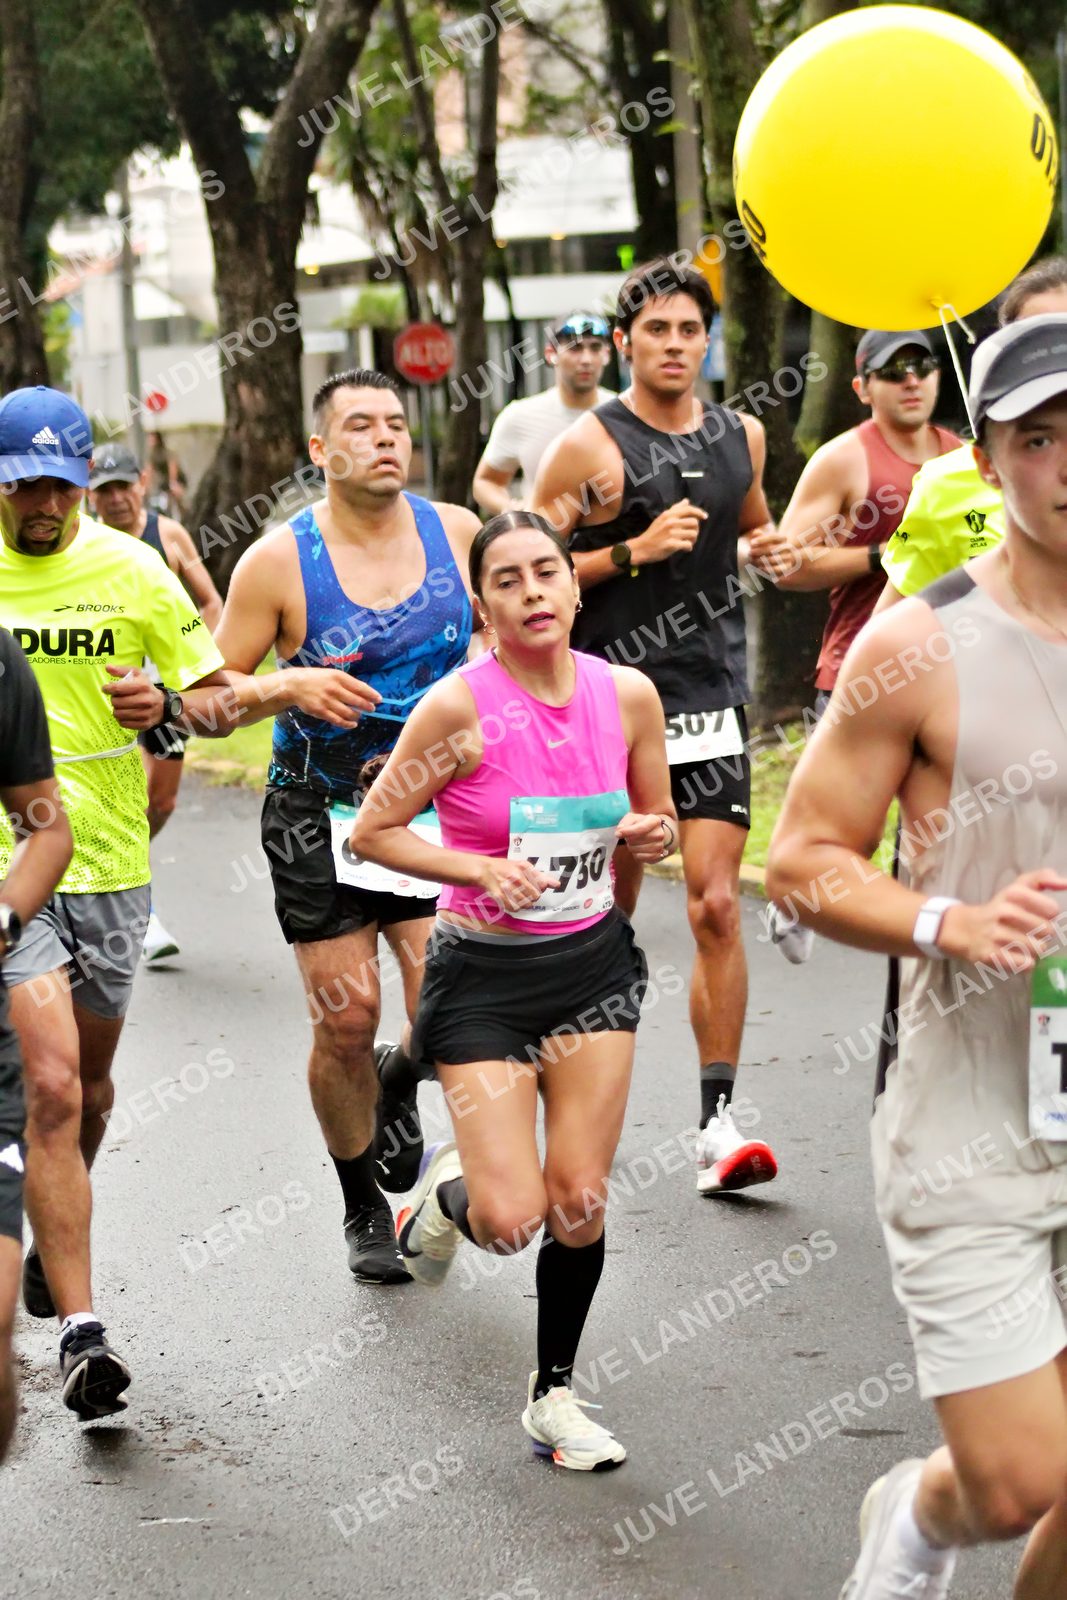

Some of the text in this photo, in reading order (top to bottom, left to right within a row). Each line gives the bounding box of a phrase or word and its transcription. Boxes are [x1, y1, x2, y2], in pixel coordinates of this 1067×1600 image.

[400, 340, 451, 365] ALTO
[32, 437, 59, 445] adidas
[76, 604, 125, 614] BROOKS
